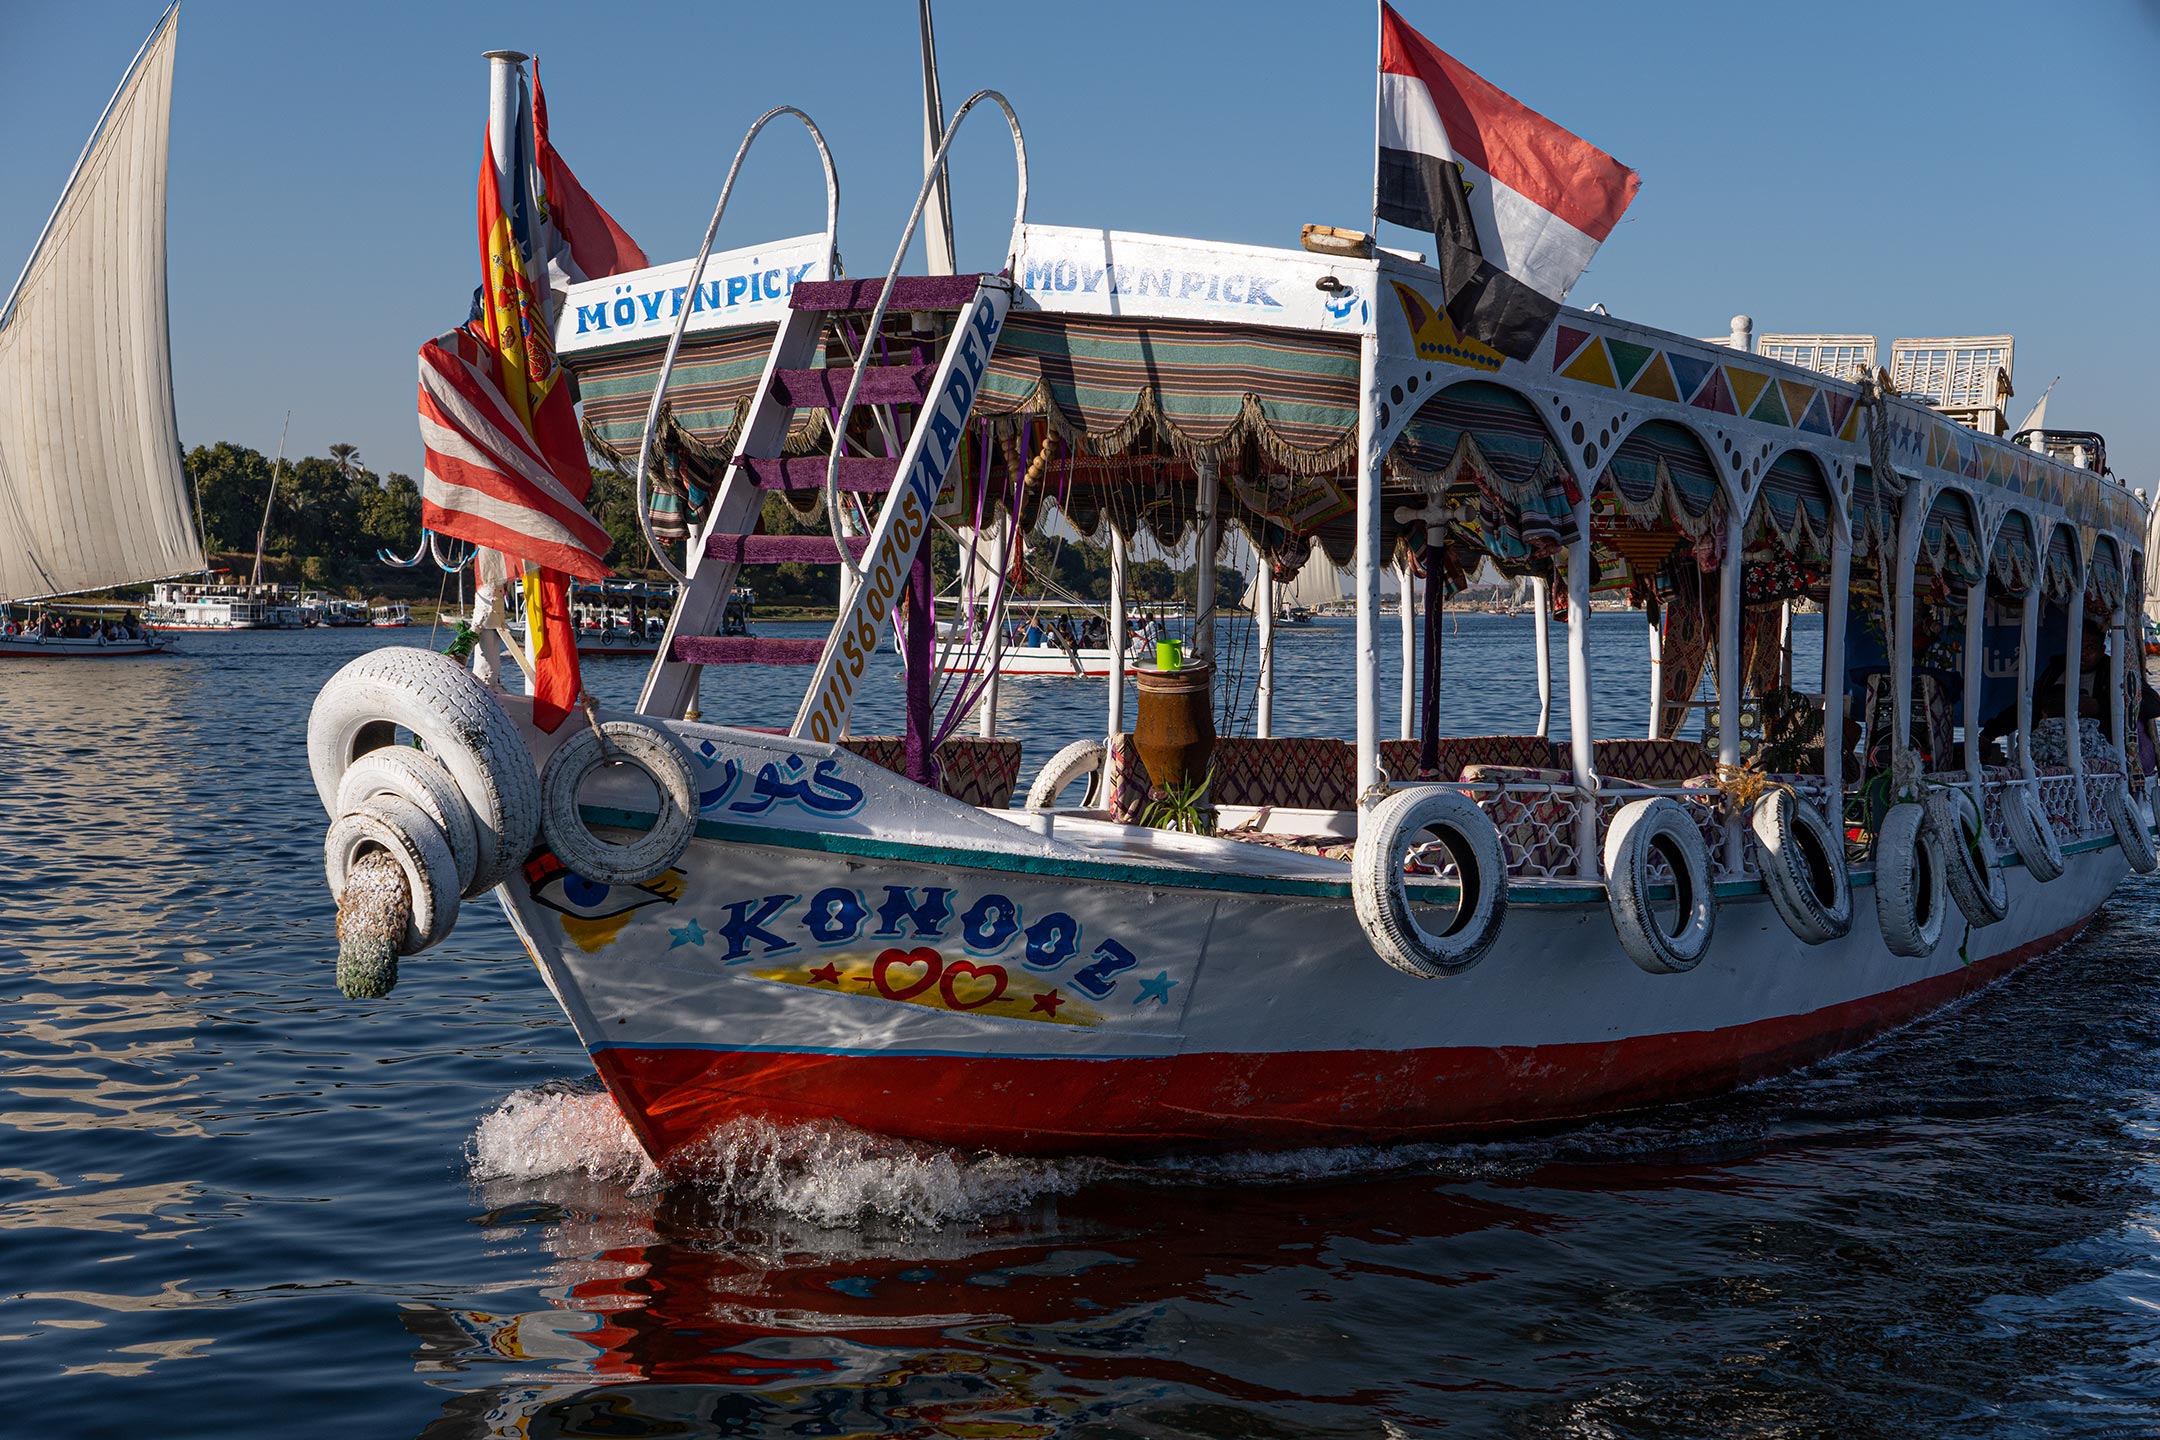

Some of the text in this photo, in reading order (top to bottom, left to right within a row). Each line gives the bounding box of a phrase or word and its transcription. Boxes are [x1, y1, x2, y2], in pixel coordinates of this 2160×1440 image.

[810, 295, 999, 744] 01115600705 NADER
[720, 884, 1137, 996] KONOOZ
